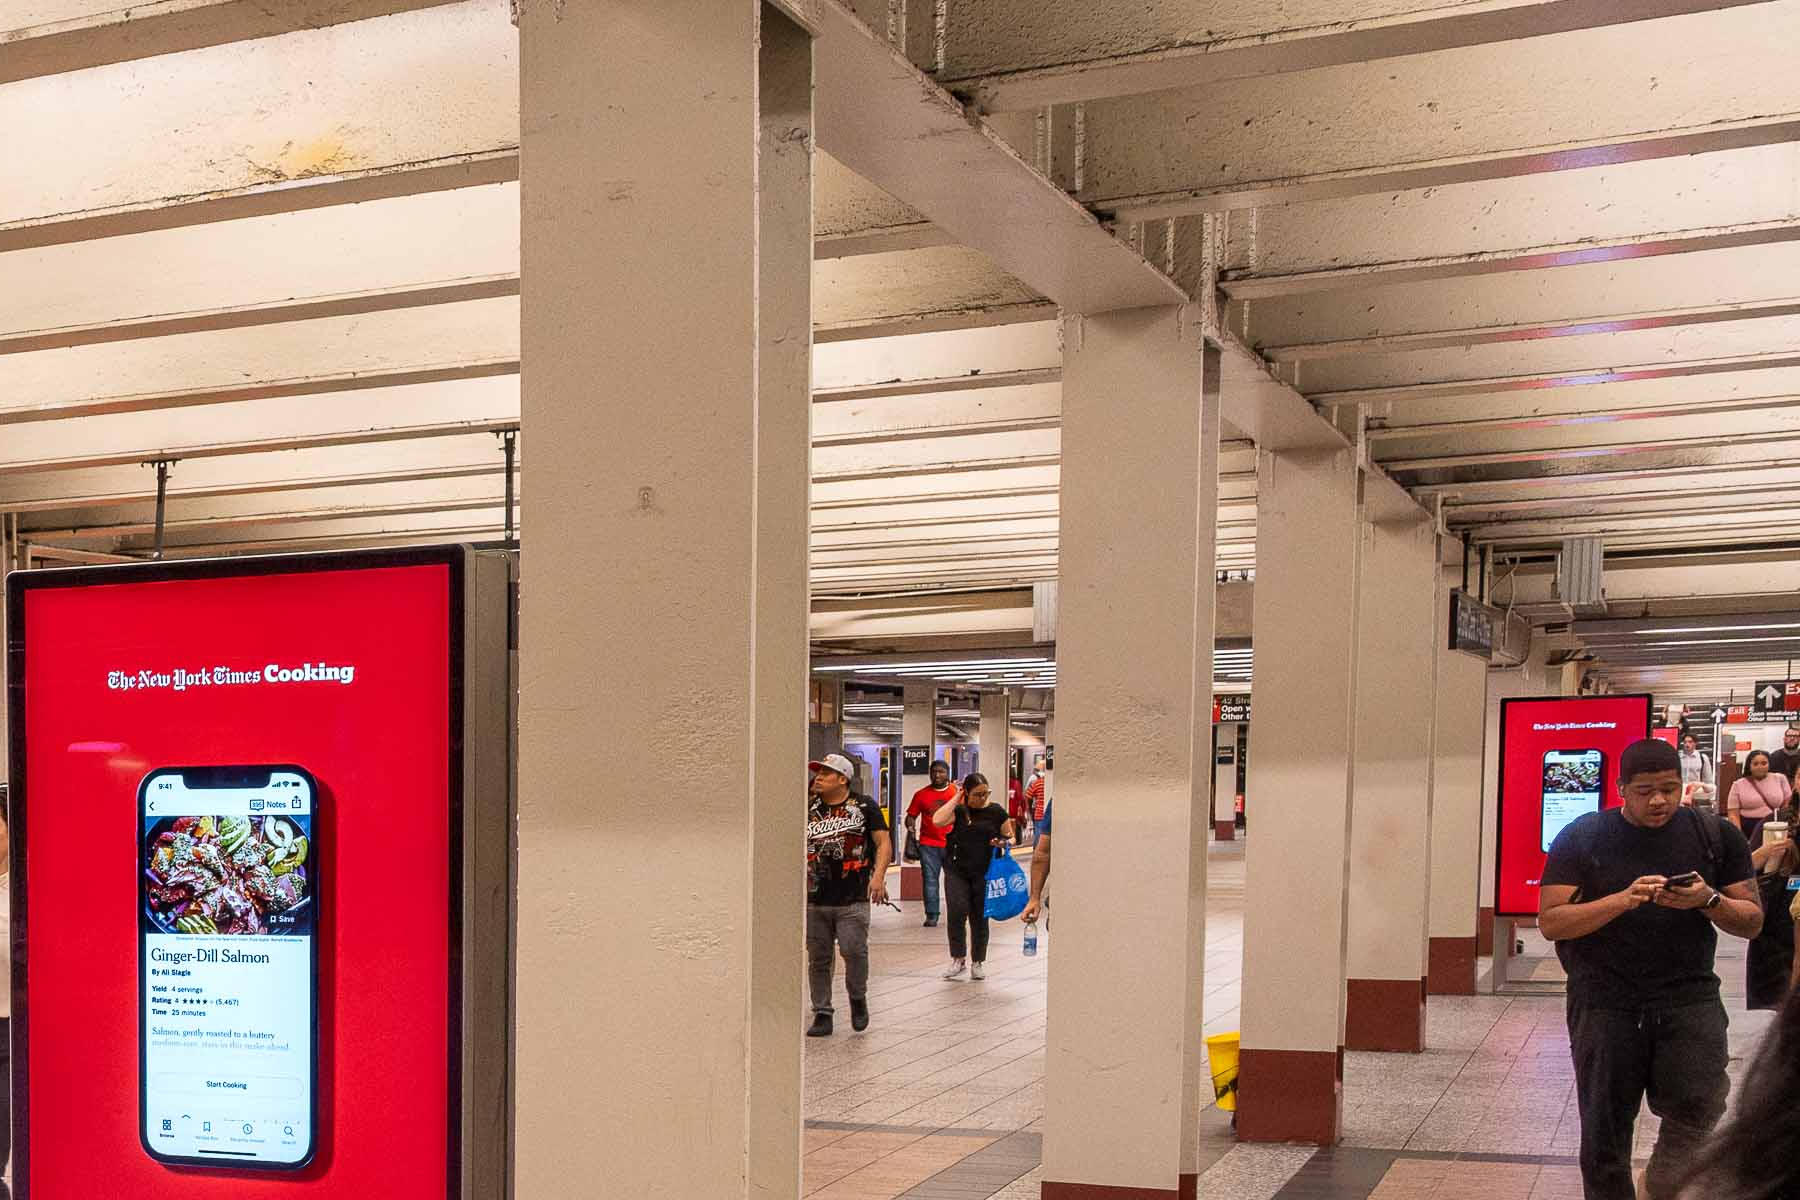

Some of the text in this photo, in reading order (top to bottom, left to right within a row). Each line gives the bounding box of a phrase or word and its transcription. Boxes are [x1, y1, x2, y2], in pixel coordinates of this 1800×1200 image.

[107, 662, 355, 691] The New York Times Cooking
[1785, 683, 1800, 695] Ex
[1221, 705, 1243, 713] Open
[904, 751, 927, 759] Track
[266, 800, 287, 809] Notes
[279, 915, 296, 924] Save
[151, 947, 270, 965] Ginger-Dill Salmon
[151, 968, 160, 977] By
[152, 985, 167, 993] Yield
[177, 986, 203, 994] servings
[151, 997, 172, 1005] Rating
[152, 1008, 167, 1016] Time
[181, 1009, 206, 1017] minutes
[151, 1026, 181, 1037] Salmon,
[182, 1028, 204, 1038] gently
[206, 1029, 232, 1038] roasted
[233, 1031, 242, 1039] to
[249, 1030, 275, 1041] buttery
[206, 1080, 248, 1090] Start Cooking
